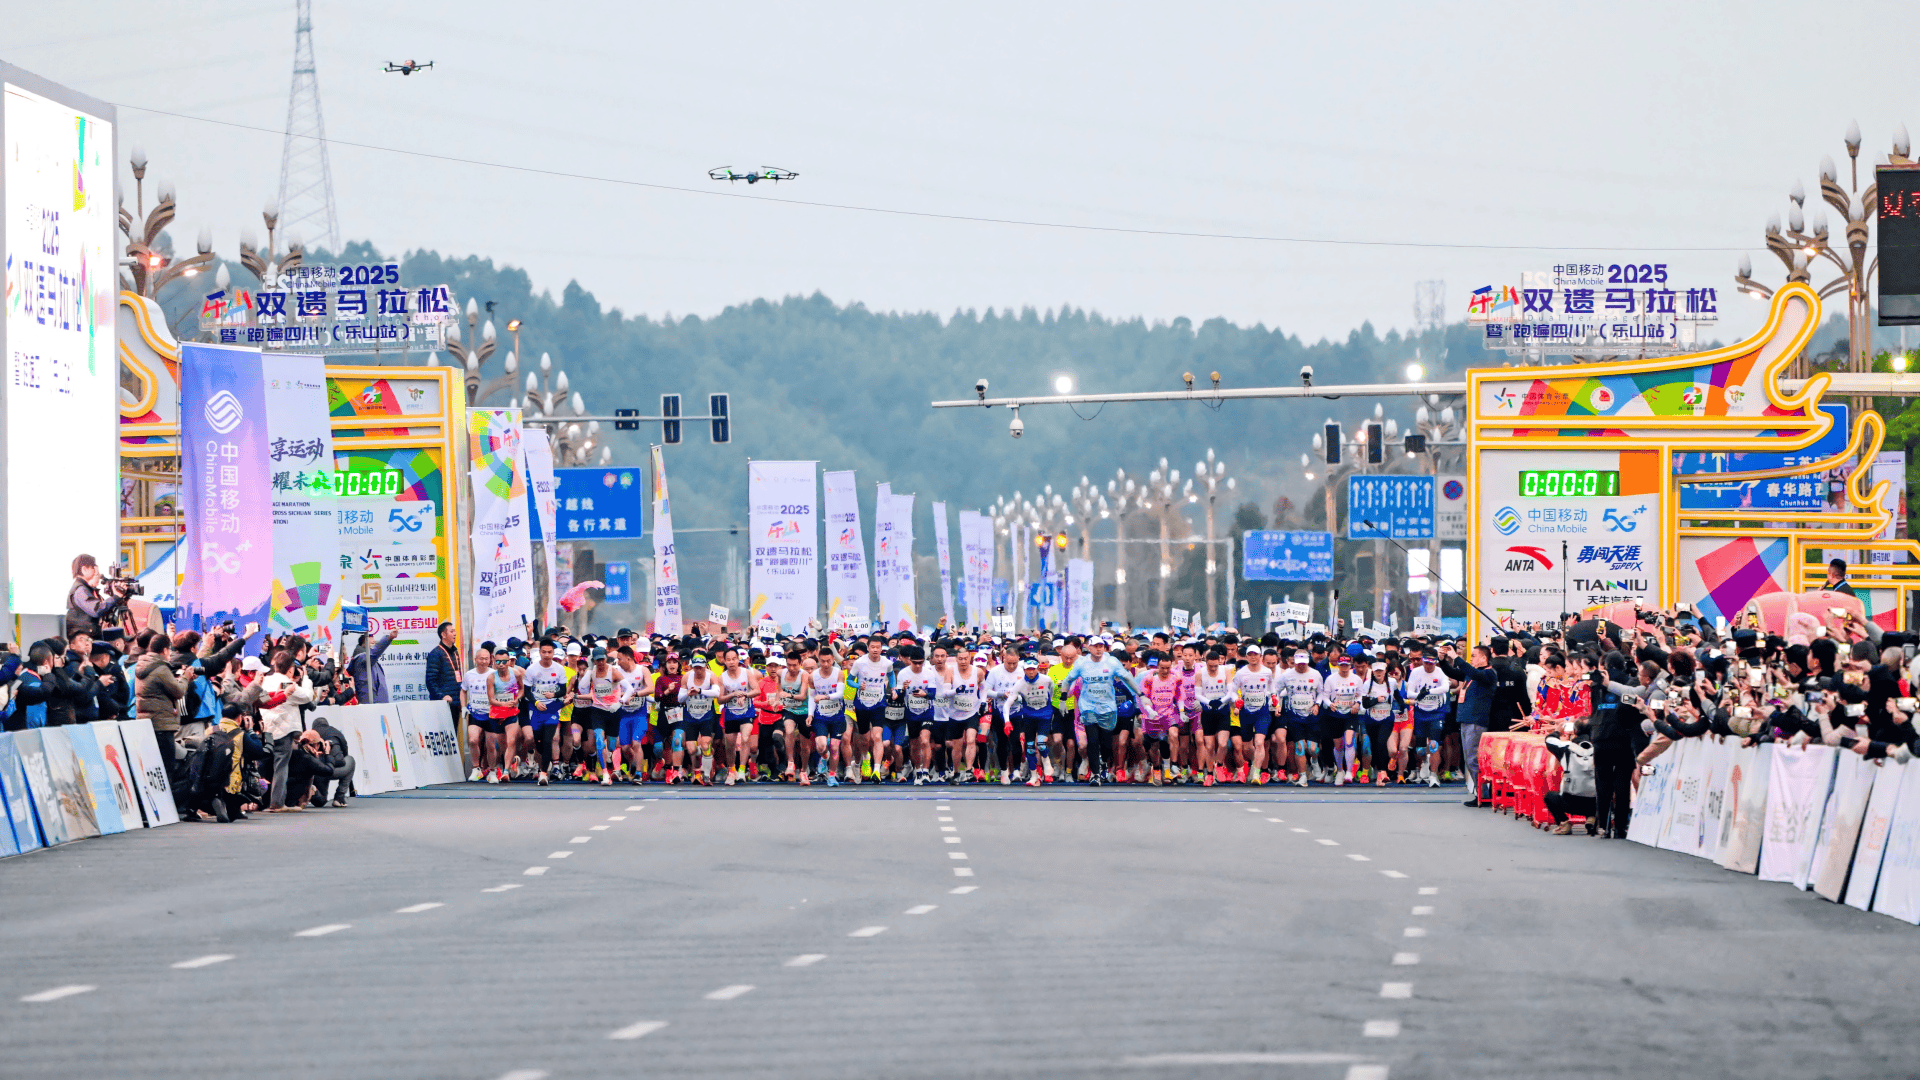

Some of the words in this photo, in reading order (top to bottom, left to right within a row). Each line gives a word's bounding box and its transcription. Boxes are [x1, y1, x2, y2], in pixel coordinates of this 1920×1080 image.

[286, 267, 335, 280] 中国移动
[340, 265, 399, 284] 2025
[1553, 264, 1604, 276] 中国移动
[1608, 264, 1668, 283] 2025
[257, 288, 449, 317] 双遗马拉松
[1523, 287, 1717, 313] 双遗马拉松
[220, 441, 239, 534] 中国移动
[1524, 472, 1615, 496] 0:00:01
[780, 505, 810, 515] 2025
[1528, 508, 1588, 522] 中国移动
[344, 526, 374, 534] Mobile
[1528, 524, 1554, 533] China
[1557, 524, 1588, 533] Mobile
[1577, 545, 1642, 563] 勇闯天涯
[1505, 559, 1535, 571] ANTA
[1573, 579, 1648, 591] TIANNIU
